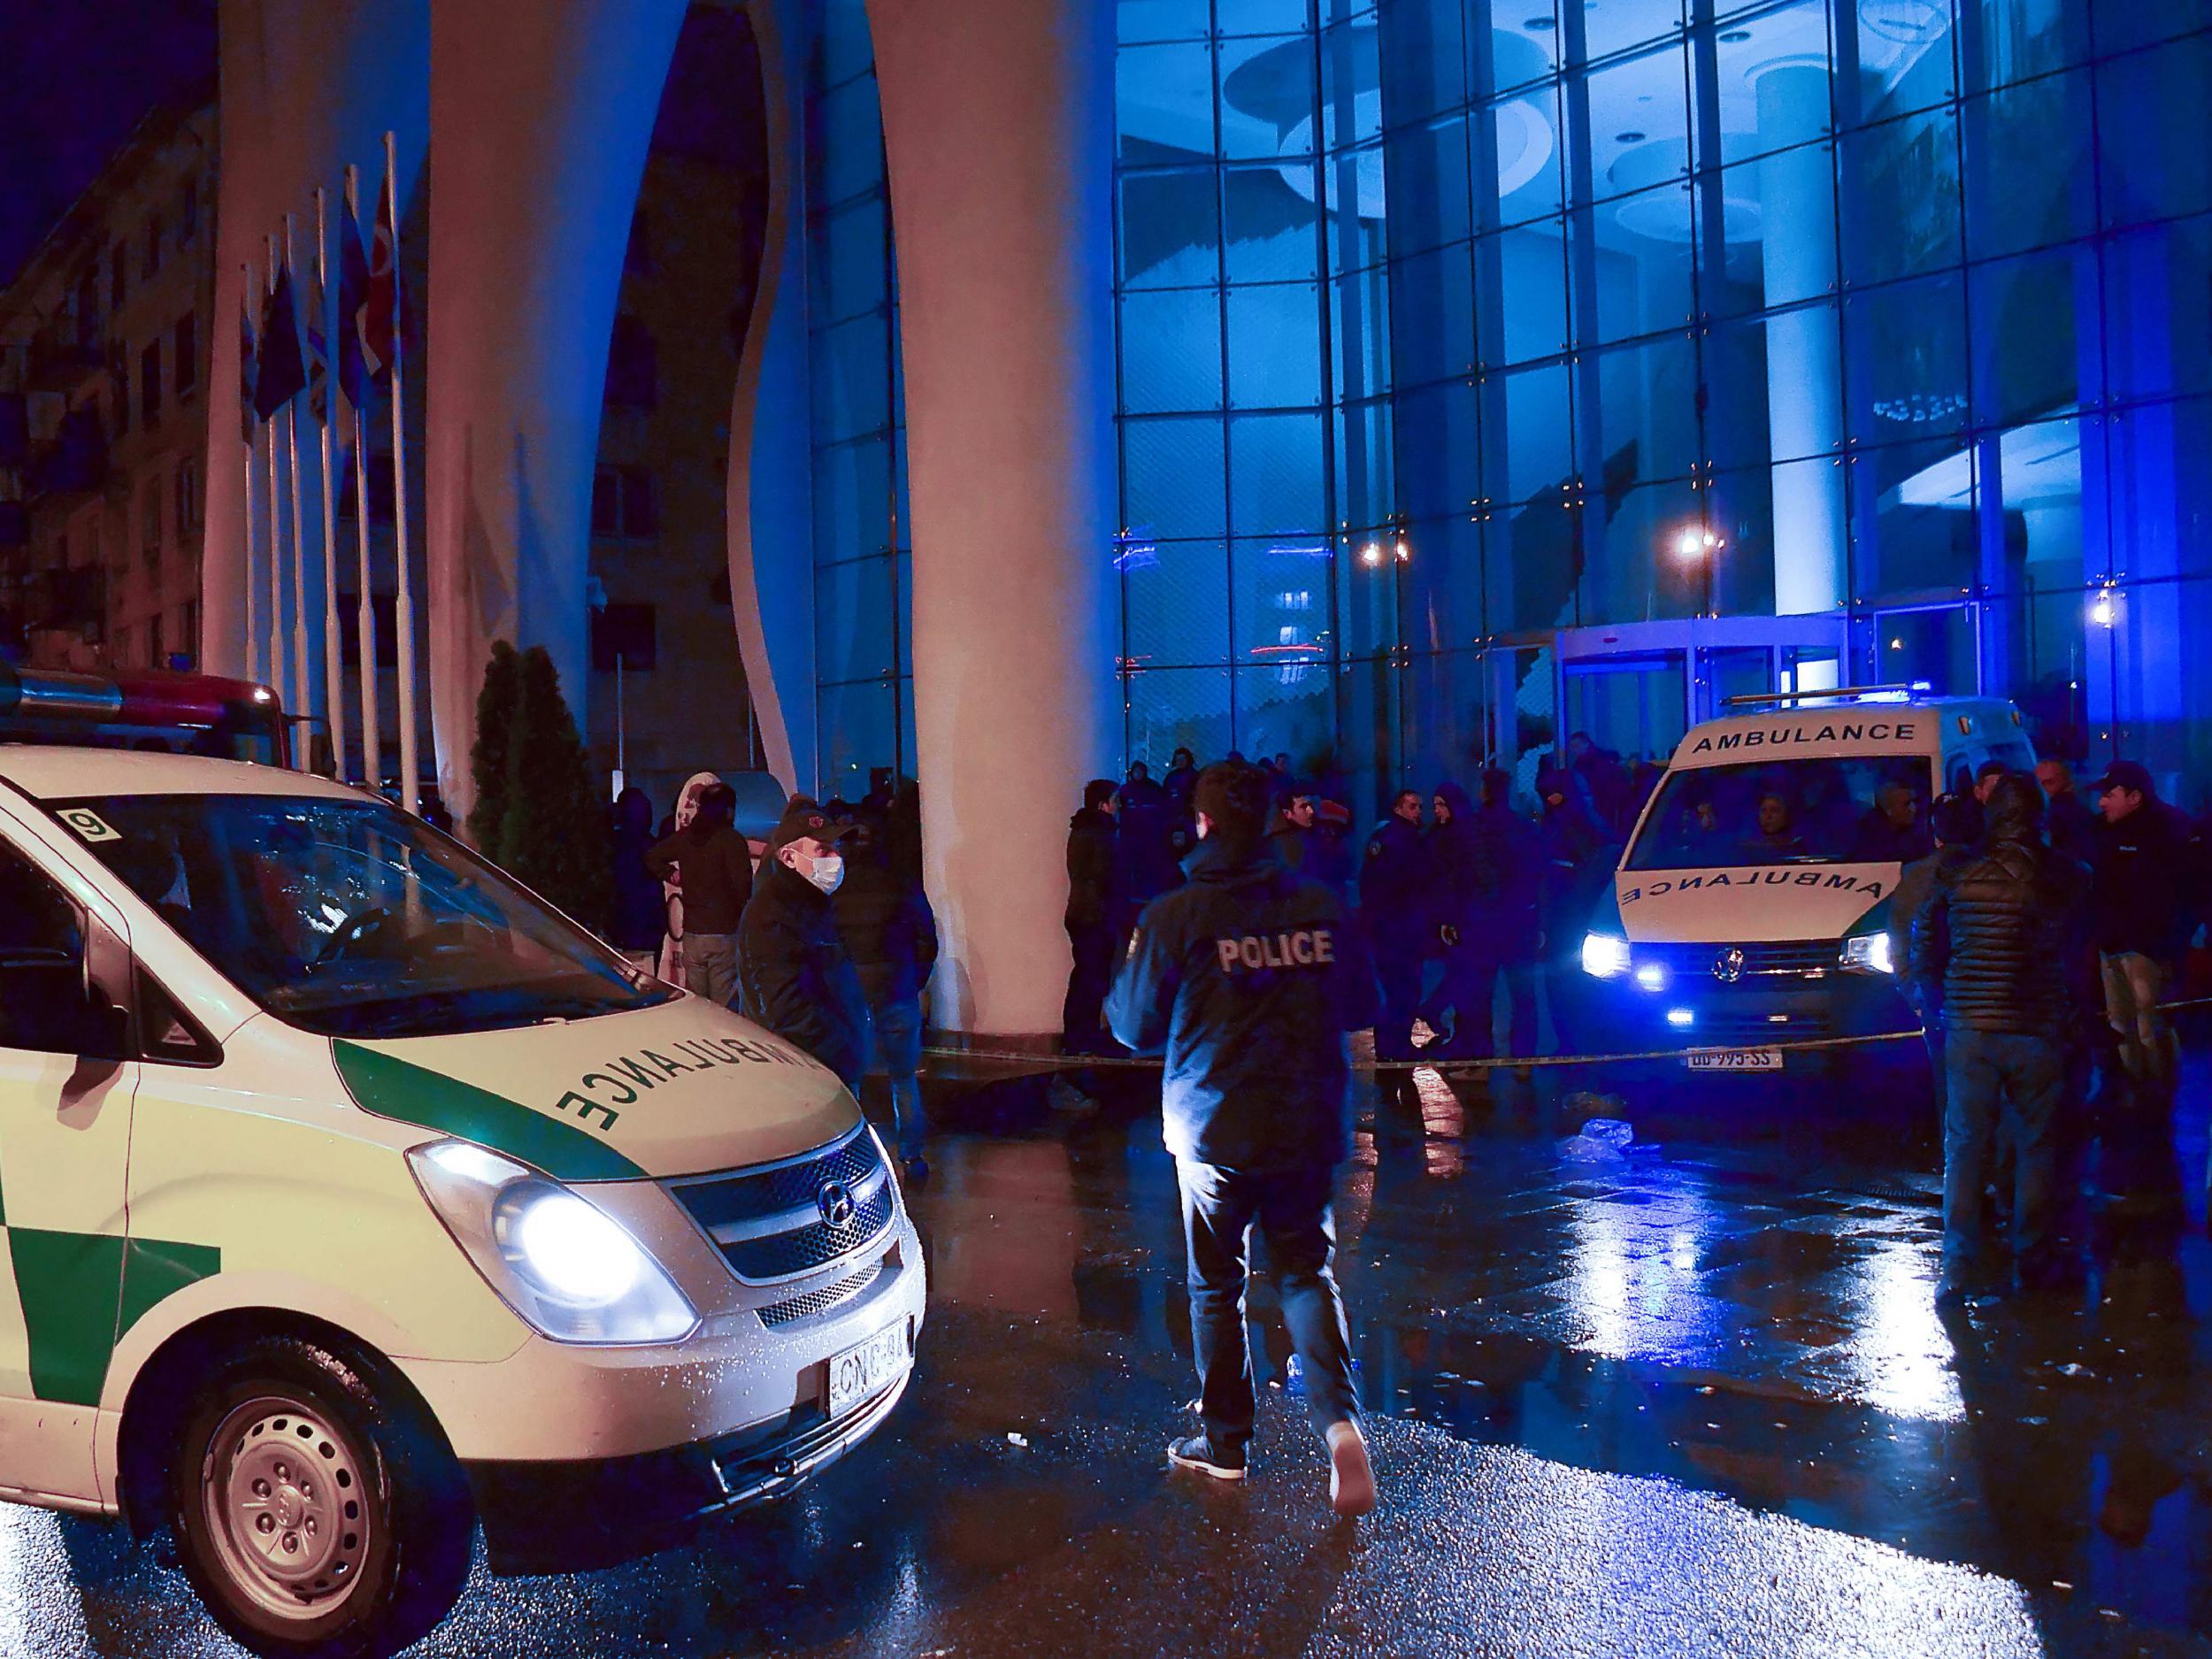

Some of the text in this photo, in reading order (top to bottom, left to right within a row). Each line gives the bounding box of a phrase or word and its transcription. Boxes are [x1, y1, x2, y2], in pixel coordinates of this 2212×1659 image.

[1692, 724, 1916, 754] AMBULANCE
[69, 813, 106, 835] 9
[1217, 930, 1336, 972] POLICE
